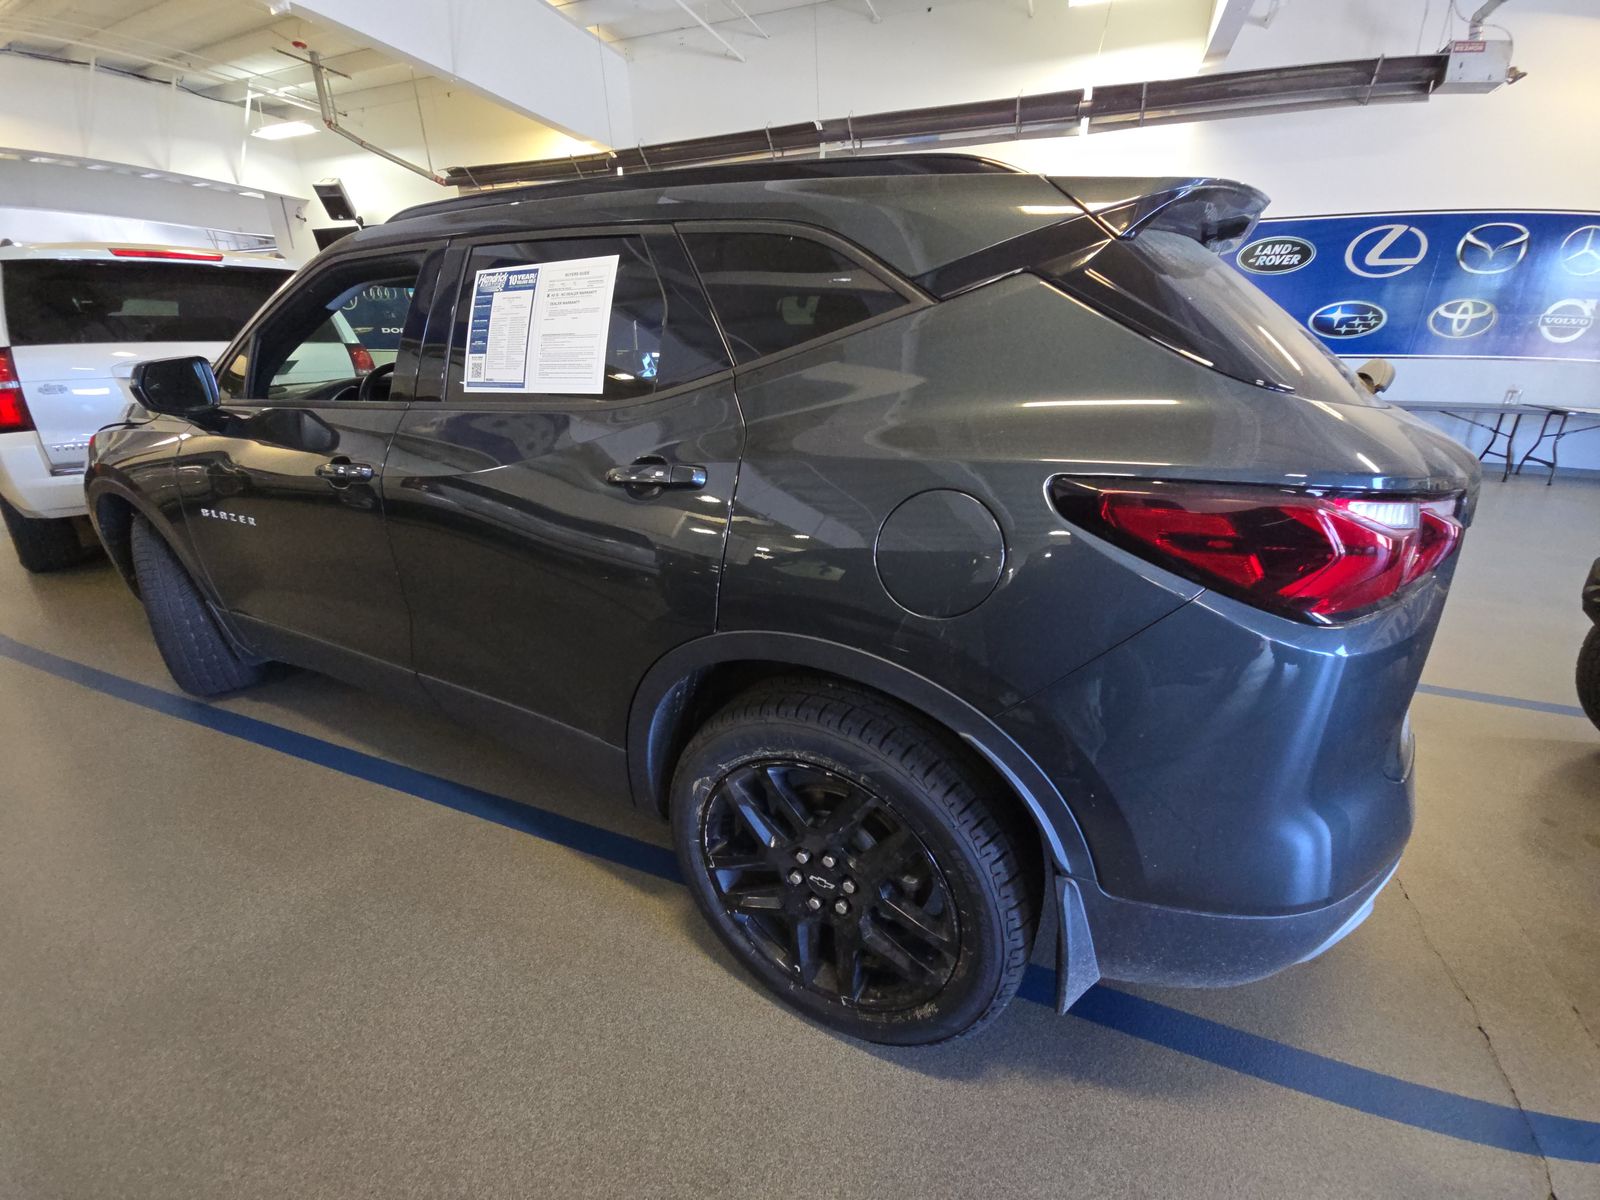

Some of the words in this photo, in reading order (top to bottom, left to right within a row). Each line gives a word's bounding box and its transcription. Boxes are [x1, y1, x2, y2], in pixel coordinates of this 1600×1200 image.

[1254, 244, 1292, 256] LAND
[1255, 254, 1302, 266] ROVER
[509, 275, 517, 286] 10
[1544, 317, 1589, 325] VOLVO
[200, 508, 257, 527] BLAZER
